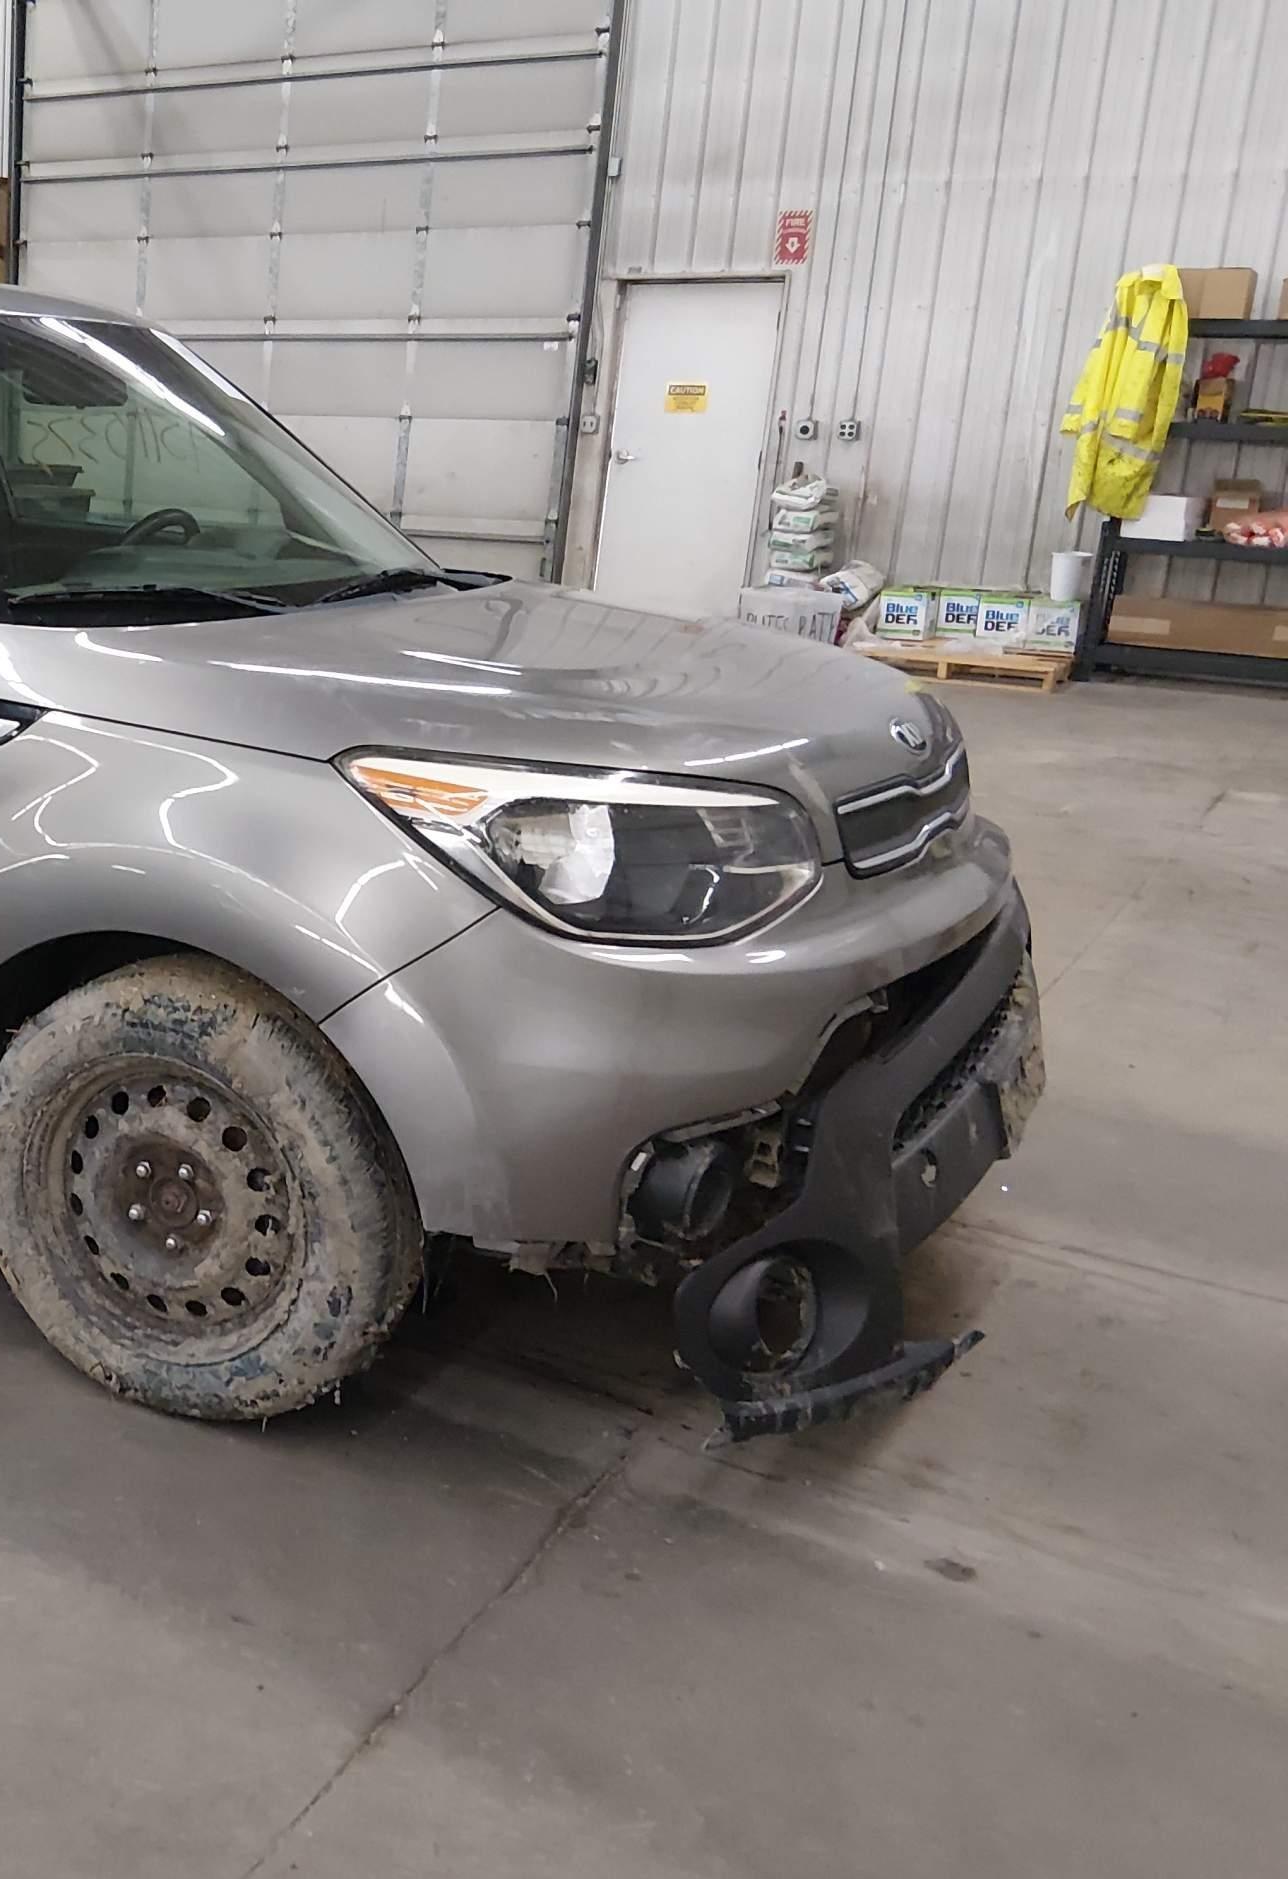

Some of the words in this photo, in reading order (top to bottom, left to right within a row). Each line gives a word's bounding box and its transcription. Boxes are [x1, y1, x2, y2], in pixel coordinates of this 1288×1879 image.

[669, 385, 705, 395] CAUTION
[886, 602, 919, 614] Blue
[985, 610, 1020, 622] Blue
